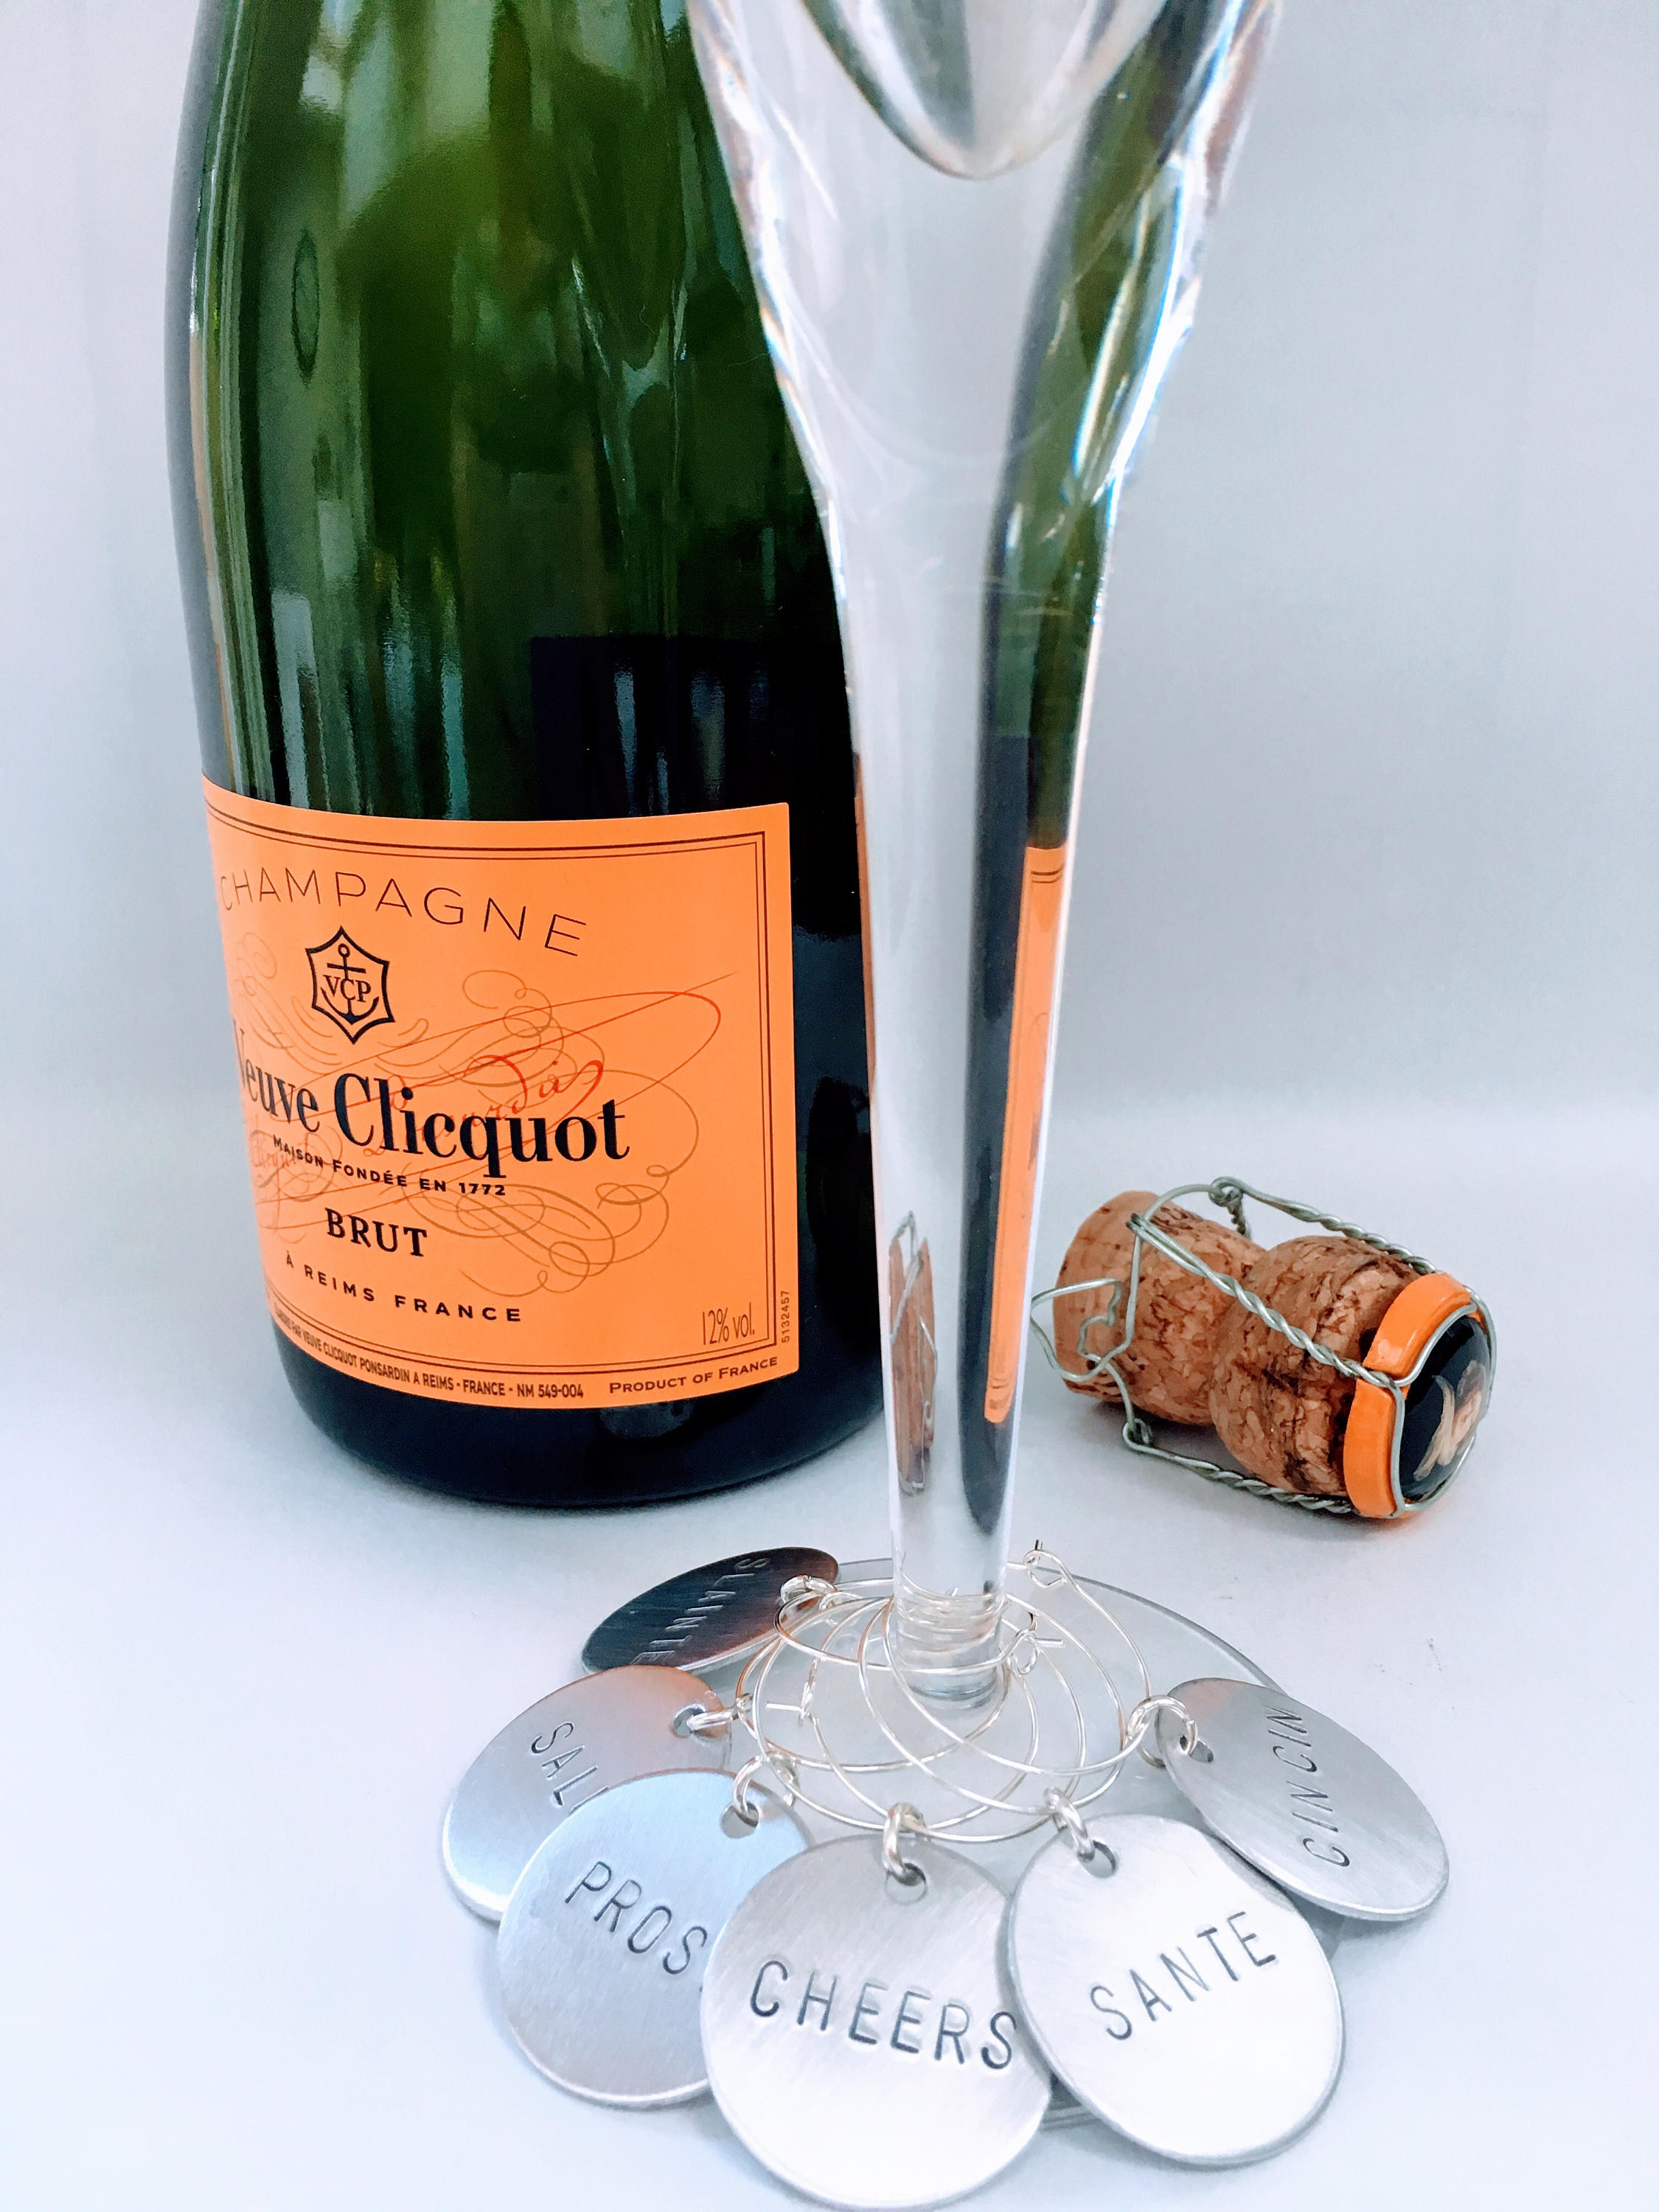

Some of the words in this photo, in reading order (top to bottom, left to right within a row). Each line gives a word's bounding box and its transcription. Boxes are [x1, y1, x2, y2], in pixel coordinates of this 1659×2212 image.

[221, 867, 587, 956] CHAMPAGNE
[323, 973, 372, 1003] VCP
[232, 1019, 320, 1133] Veuve
[334, 1072, 630, 1179] Clicquot
[273, 1133, 324, 1167] MAISON
[332, 1158, 408, 1187] FONDÉE
[419, 1178, 447, 1192] EN
[459, 1182, 506, 1196] 1772
[324, 1207, 428, 1257] BRUT
[305, 1263, 376, 1302] REIMS
[394, 1294, 522, 1323] FRANCE
[702, 1306, 730, 1346] 12%
[732, 1301, 755, 1340] vol.
[780, 1290, 790, 1344] 5132457
[323, 1341, 358, 1368] CLICQUOT
[359, 1357, 411, 1383] PONSARDIN
[422, 1372, 454, 1391] REIMS
[462, 1379, 506, 1396] FRANCE
[517, 1383, 535, 1397] NM
[538, 1383, 584, 1398] 549-004
[530, 1721, 611, 1815] SAL
[1263, 1705, 1318, 1773] CIN
[1285, 1780, 1351, 1868] CIN
[564, 1860, 709, 1990] PROS
[1089, 1910, 1277, 2041] SANTE
[749, 1959, 1018, 2070] CHEERS
